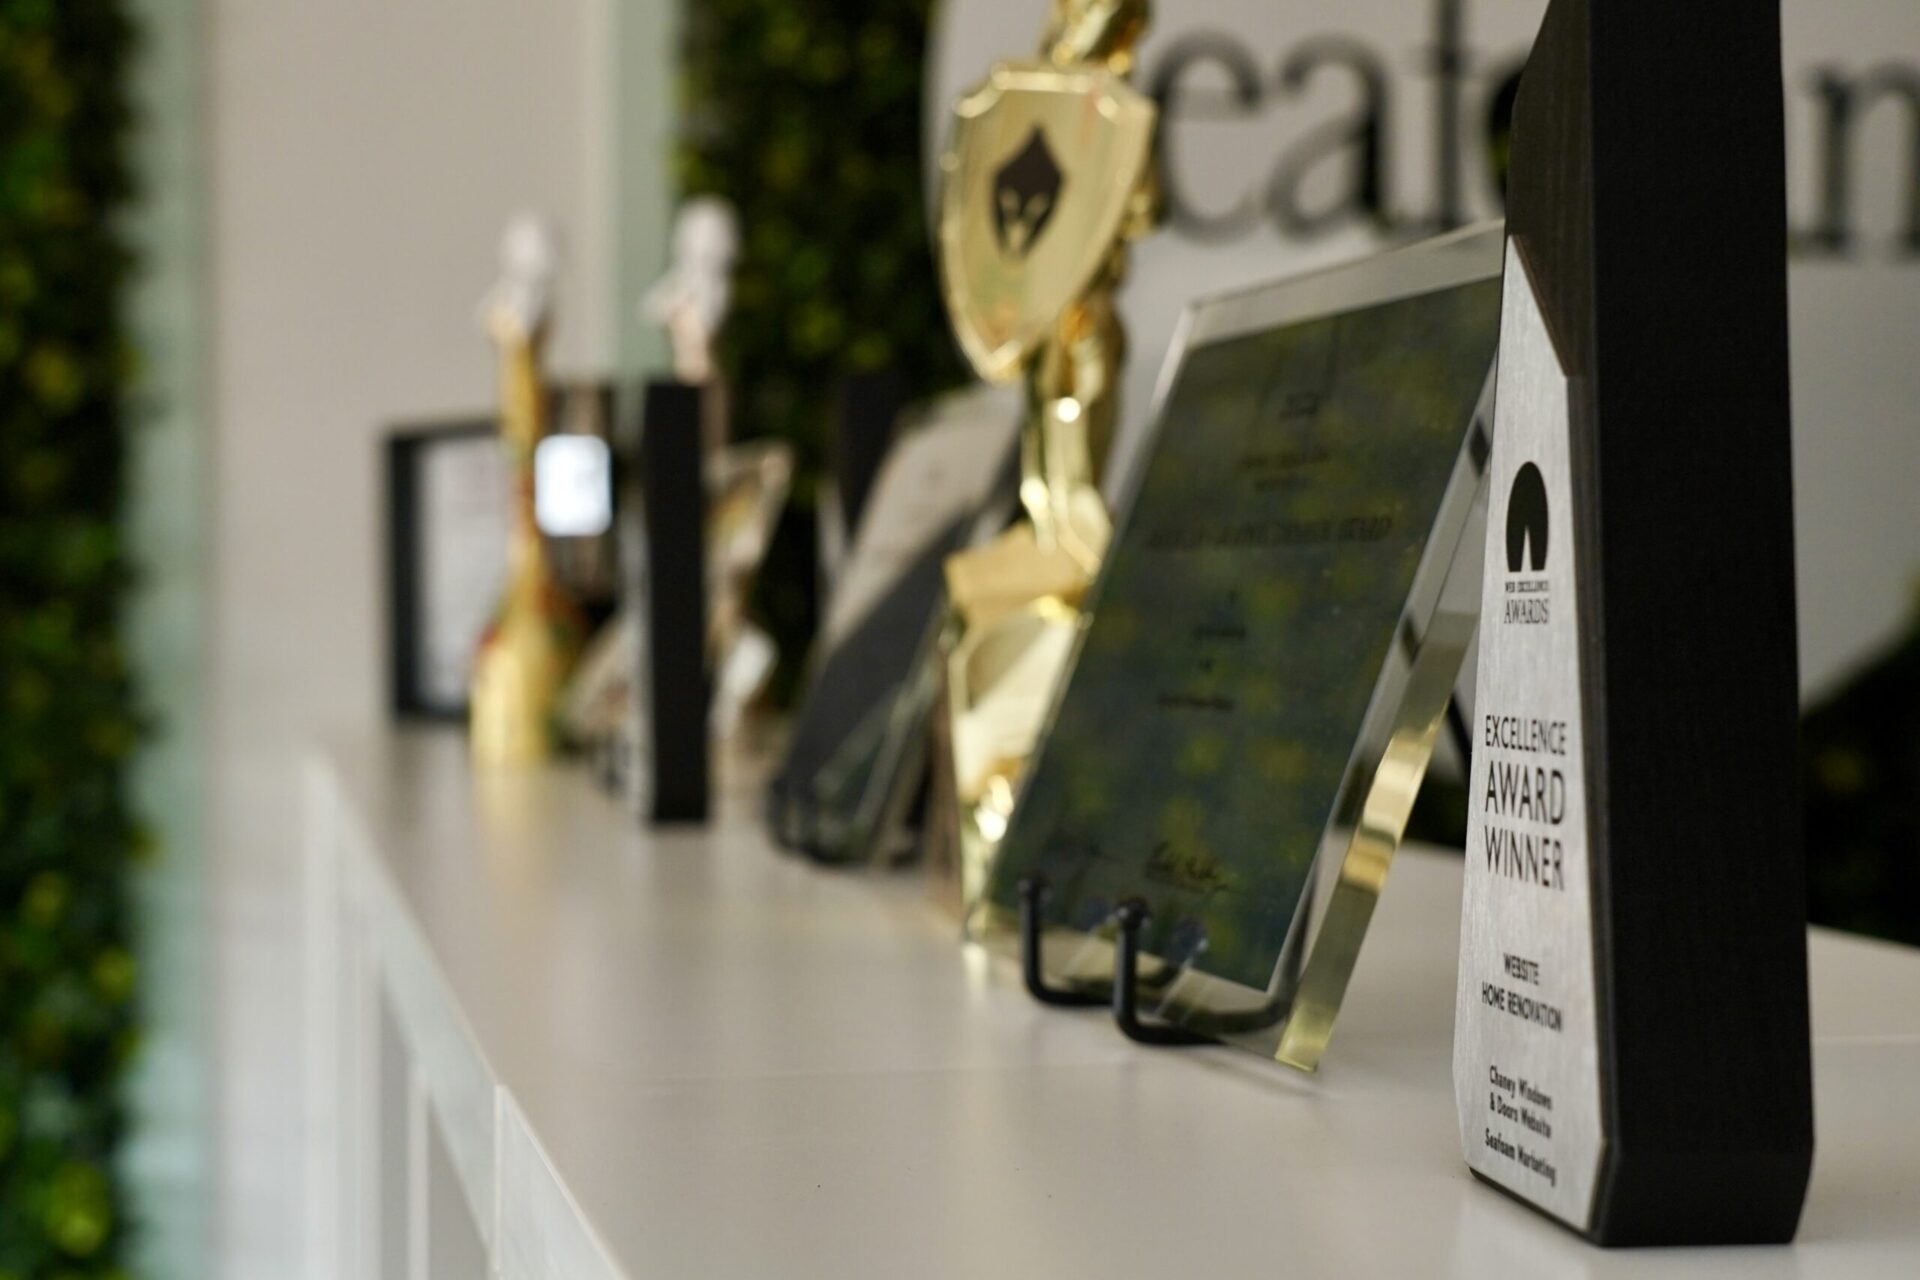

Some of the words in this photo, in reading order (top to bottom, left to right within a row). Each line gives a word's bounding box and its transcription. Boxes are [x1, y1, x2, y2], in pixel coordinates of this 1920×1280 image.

[1503, 598, 1550, 624] AWARDS
[1485, 714, 1567, 756] EXCELLENCE
[1485, 760, 1566, 826] AWARD
[1484, 825, 1565, 891] WINNER
[1503, 952, 1539, 986] WEBSITE
[1481, 980, 1505, 1012] HOME
[1507, 990, 1563, 1033] RENOVATION
[1489, 1065, 1516, 1099] Chaney
[1518, 1078, 1552, 1111] Windows
[1497, 1095, 1518, 1123] Doors
[1521, 1107, 1551, 1139] Website
[1485, 1127, 1516, 1161] Seafoam
[1517, 1144, 1556, 1188] Marketing
